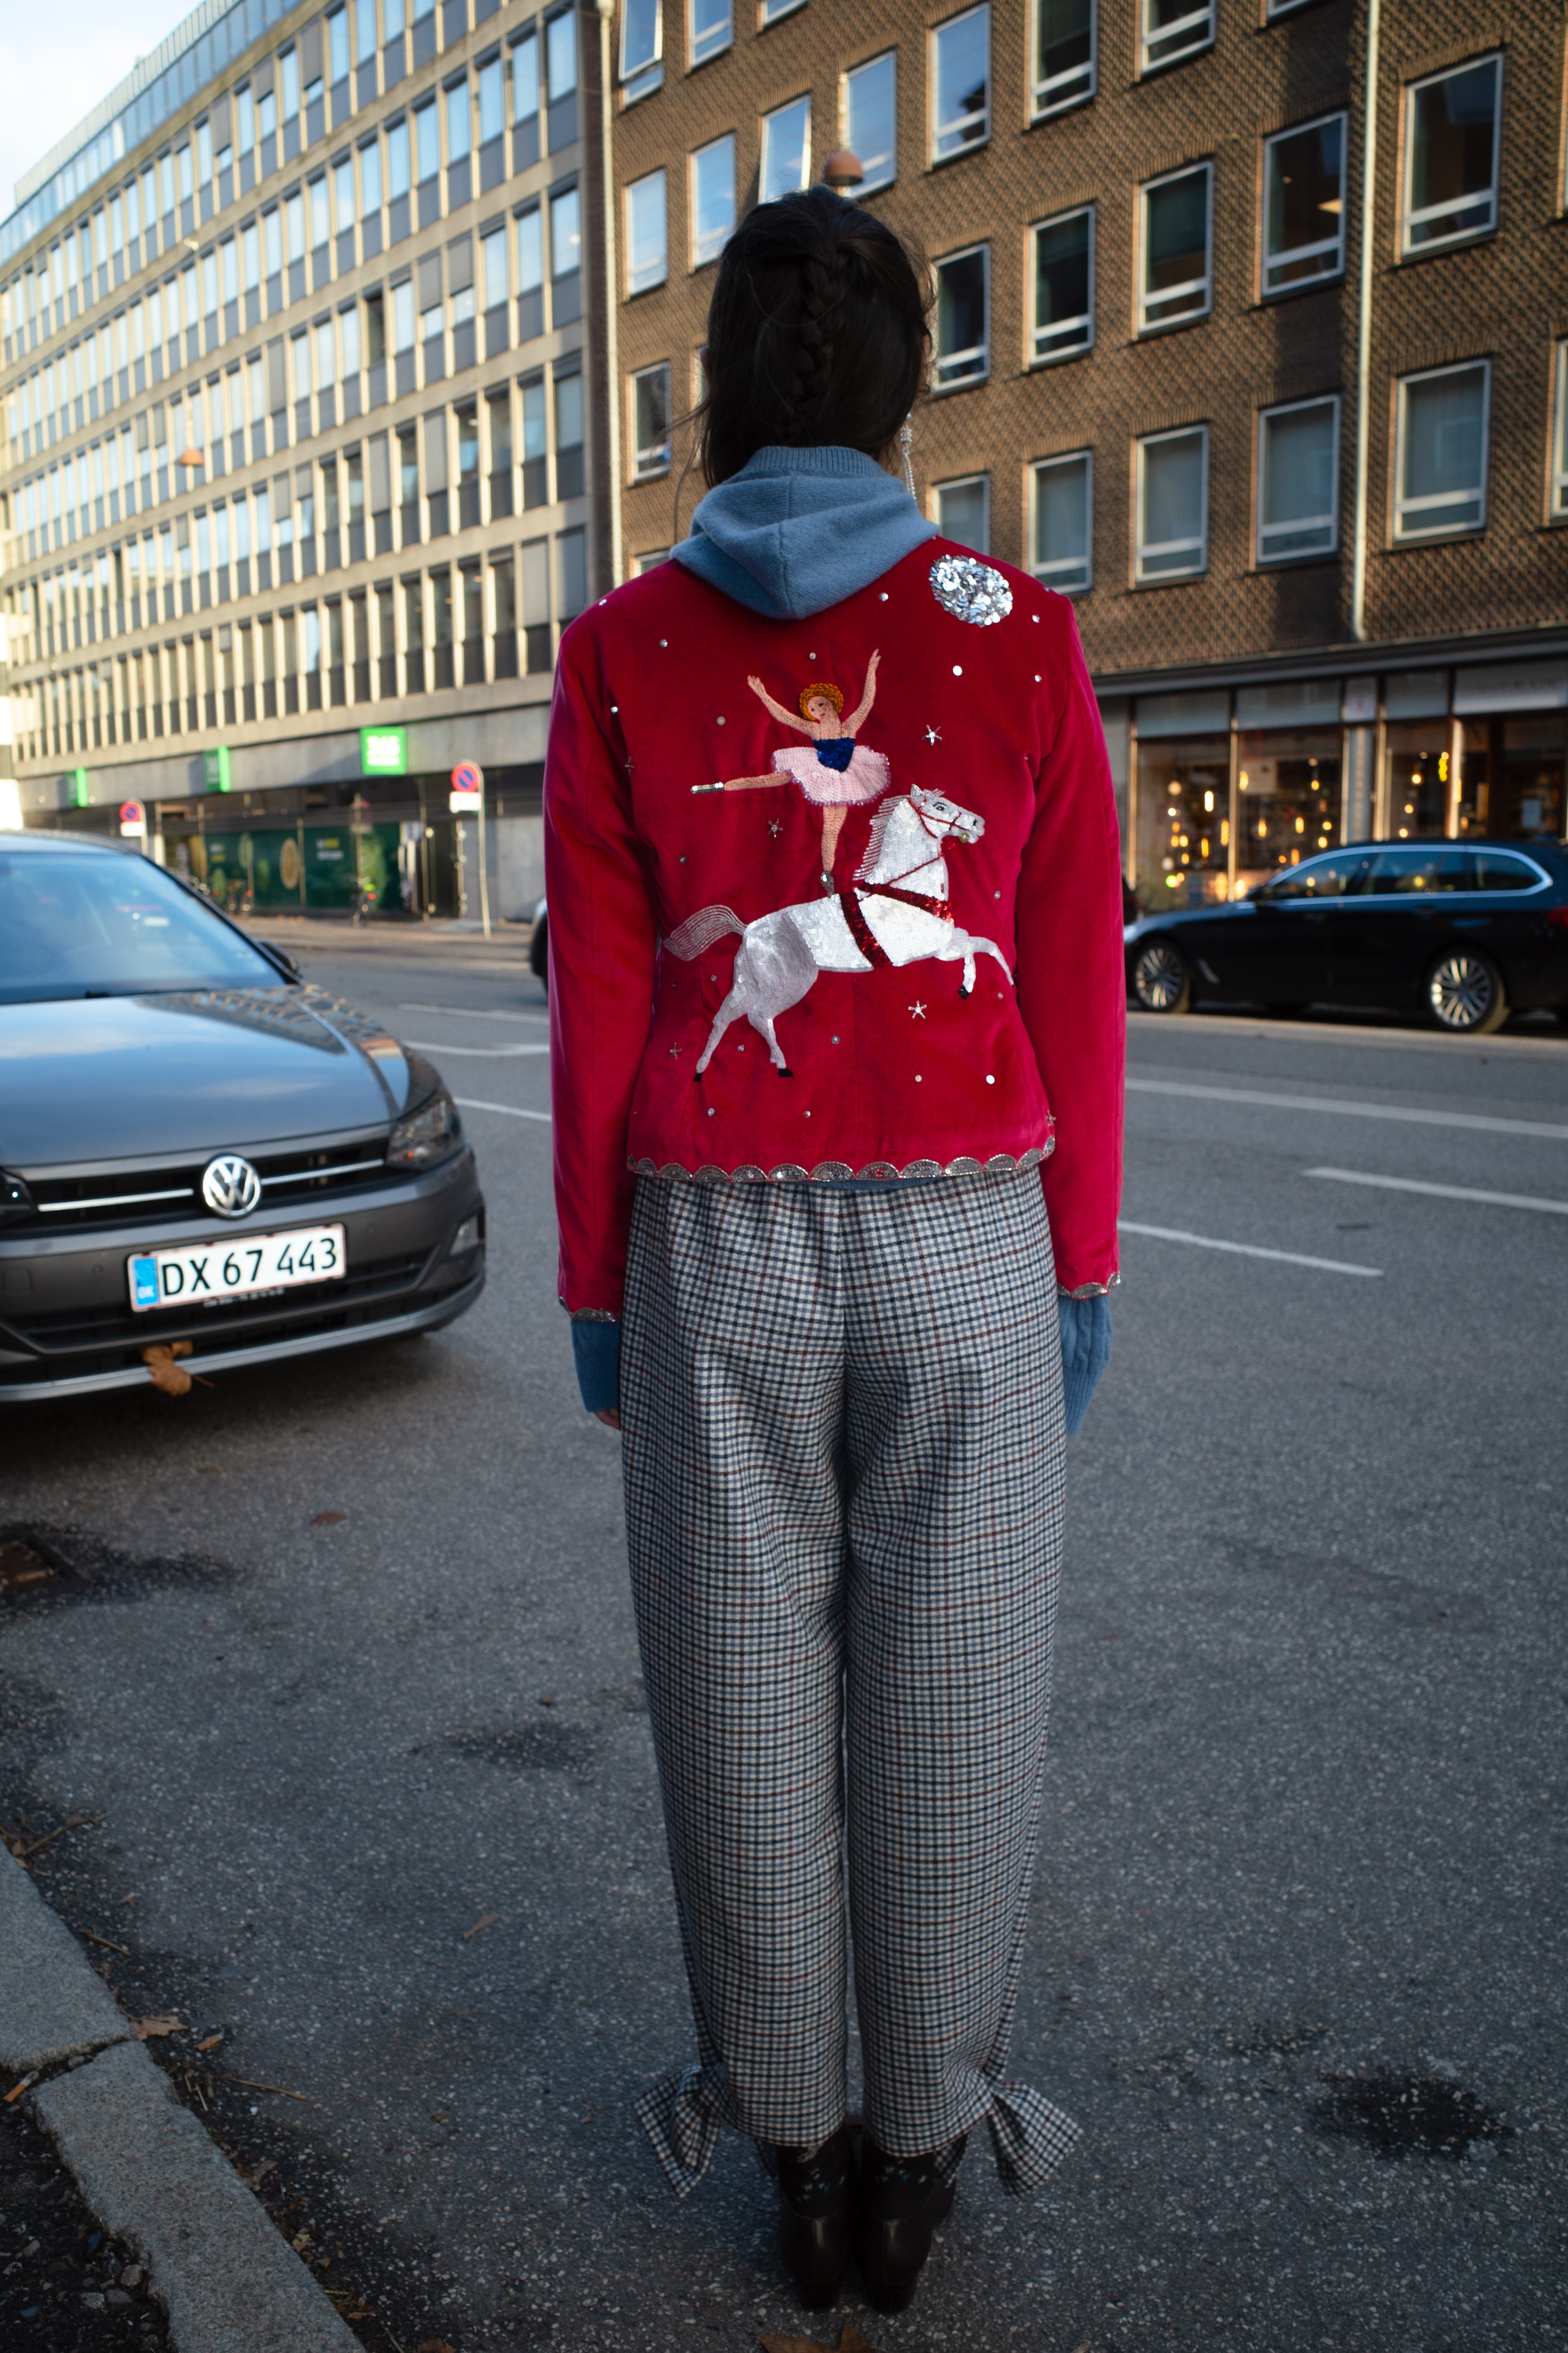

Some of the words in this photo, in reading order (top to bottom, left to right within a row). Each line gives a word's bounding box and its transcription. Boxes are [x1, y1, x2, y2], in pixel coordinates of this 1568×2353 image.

[206, 1157, 257, 1213] VW
[138, 1285, 155, 1299] DK
[161, 1258, 211, 1296] DX
[223, 1249, 263, 1286] 67
[277, 1238, 337, 1275] 443
